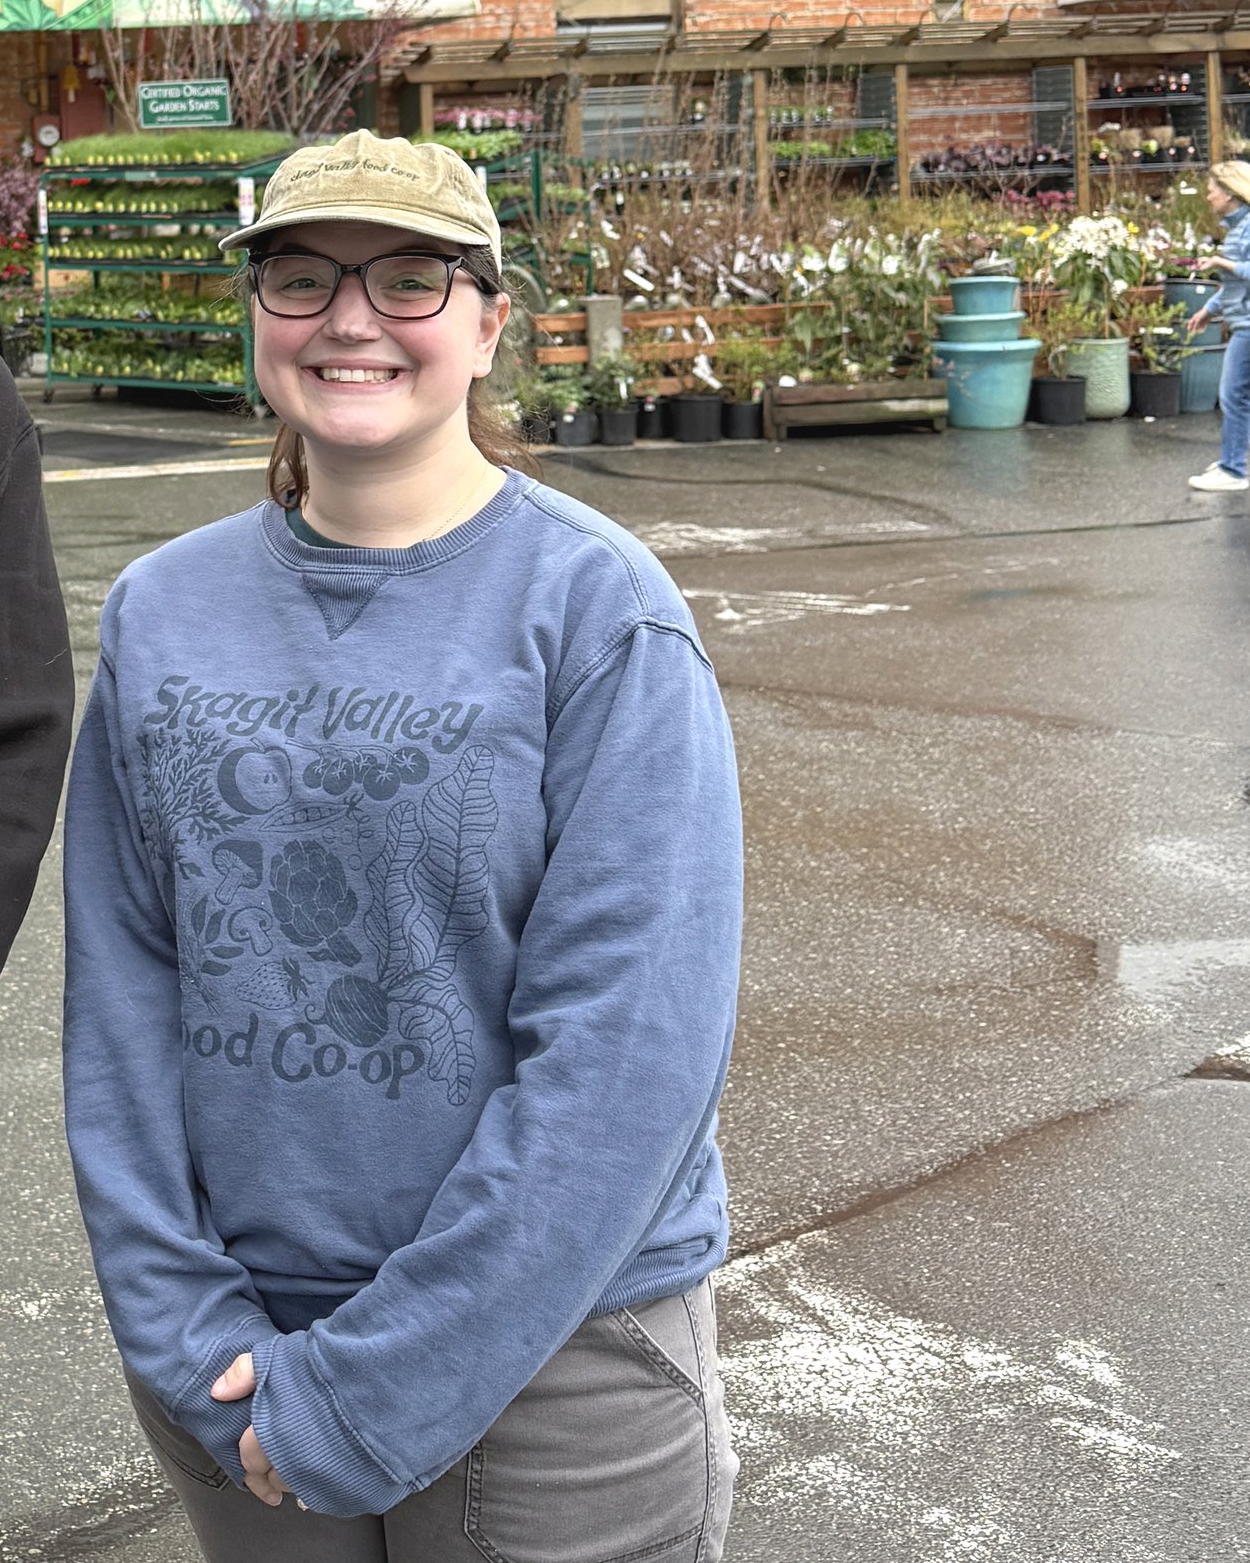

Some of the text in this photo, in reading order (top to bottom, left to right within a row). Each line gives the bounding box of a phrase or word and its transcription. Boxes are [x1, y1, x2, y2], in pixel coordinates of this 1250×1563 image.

[149, 99, 220, 113] GARDEN STARTS
[183, 85, 227, 97] ORGANIC
[143, 674, 485, 755] Skagit Valley
[271, 1022, 425, 1100] Co-op
